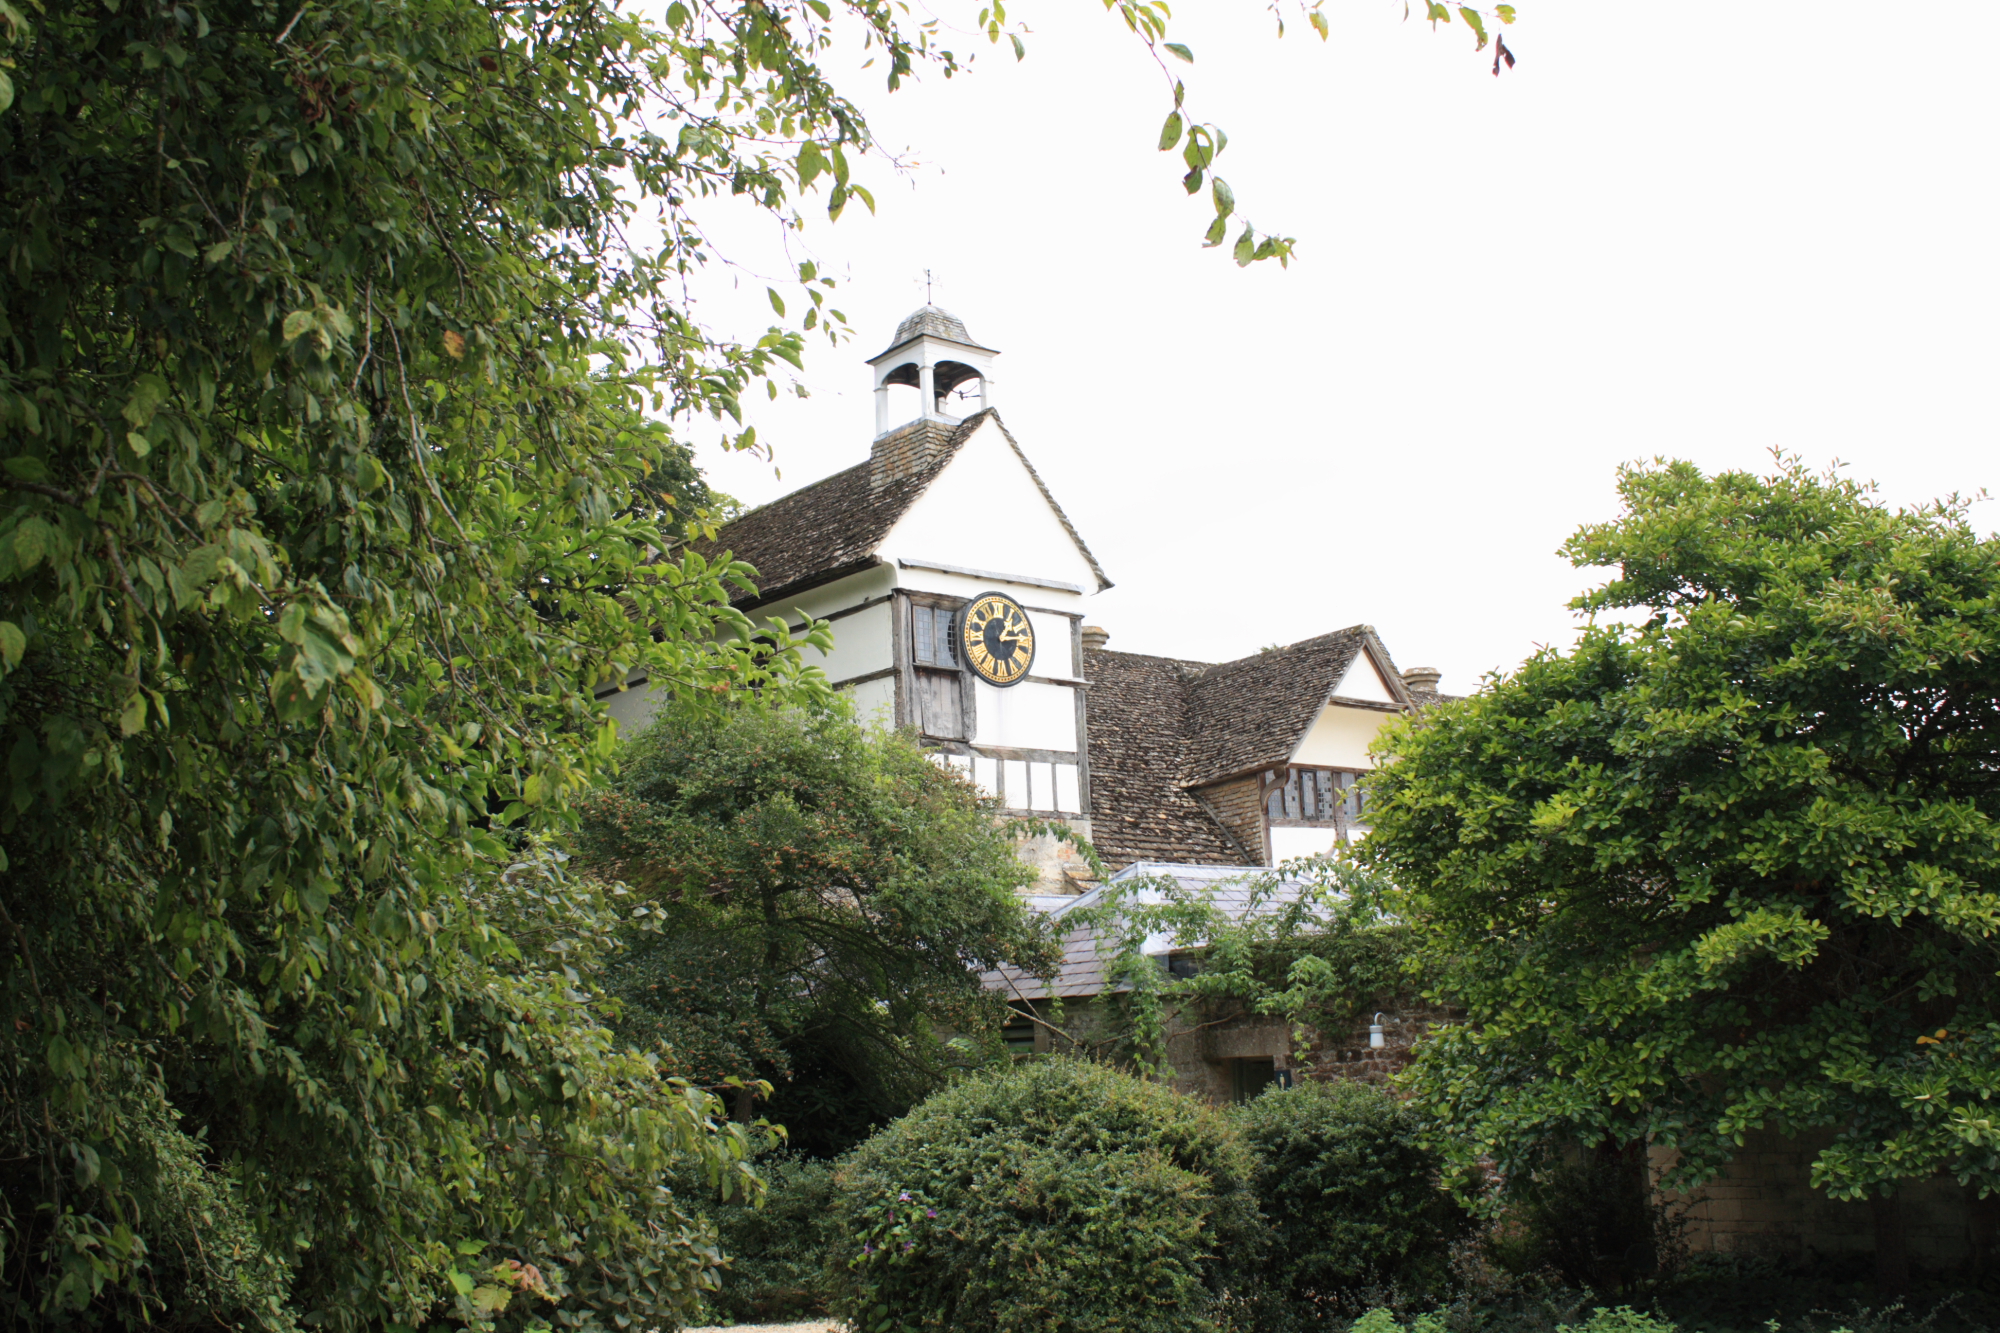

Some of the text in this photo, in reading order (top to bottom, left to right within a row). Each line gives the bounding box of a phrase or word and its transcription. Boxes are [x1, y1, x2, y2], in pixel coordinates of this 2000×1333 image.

[992, 602, 1004, 618] XII
[1013, 621, 1025, 633] II
[997, 660, 1008, 676] VI
[1008, 658, 1018, 674] V
